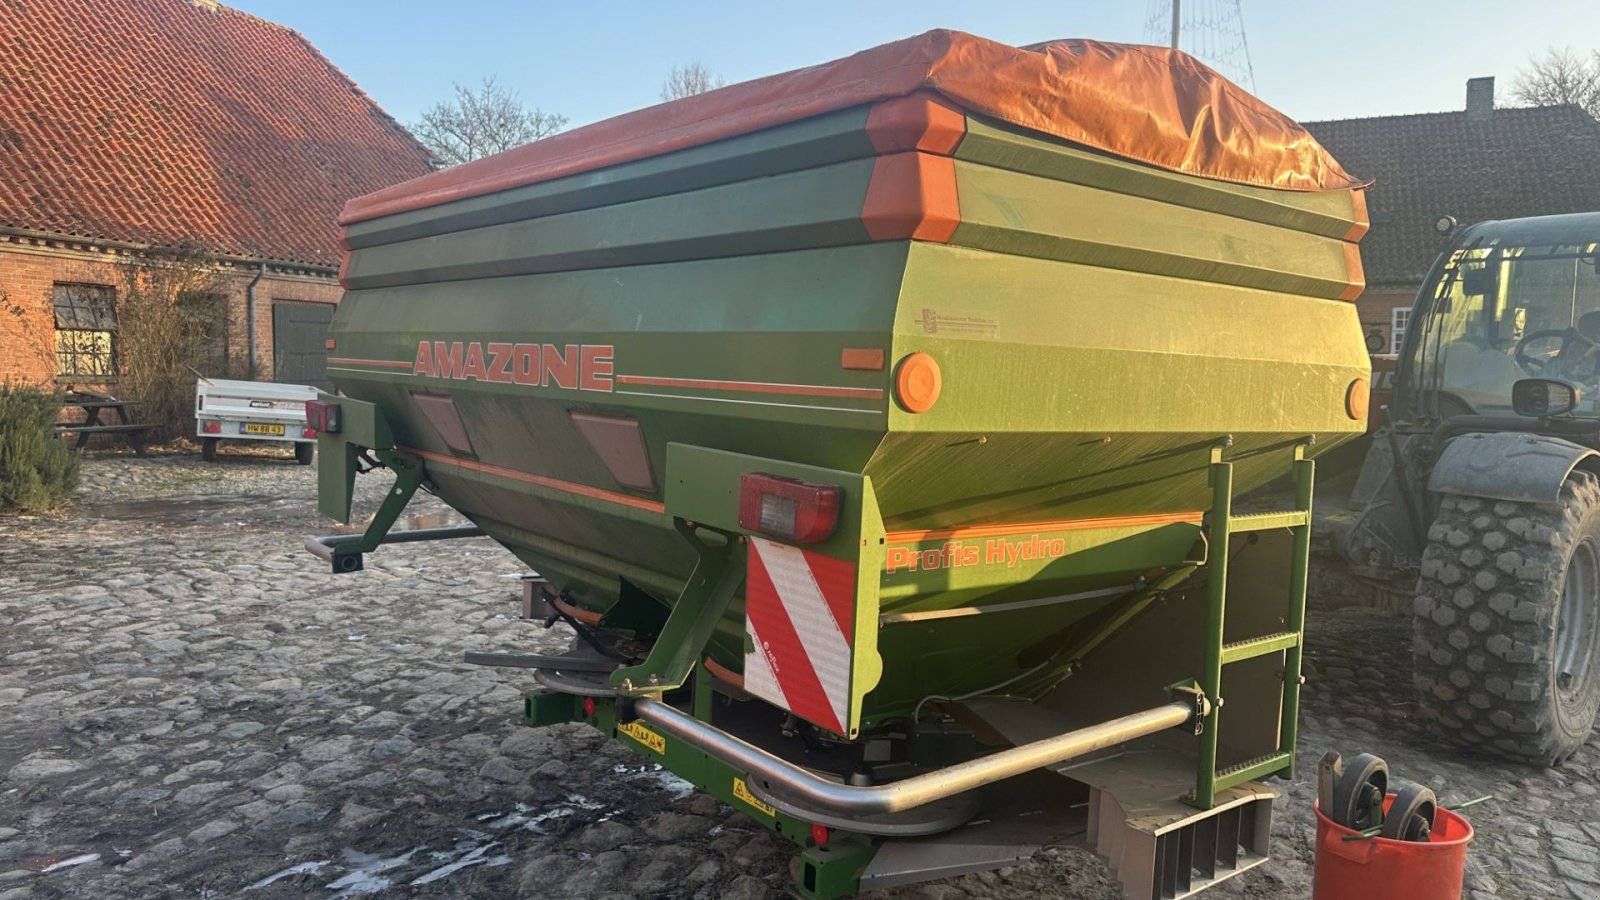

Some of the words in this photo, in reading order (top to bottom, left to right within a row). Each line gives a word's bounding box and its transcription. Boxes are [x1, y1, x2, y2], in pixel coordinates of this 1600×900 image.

[413, 340, 614, 393] AMAZONE
[886, 541, 980, 574] Profis
[985, 535, 1066, 568] Hydro
